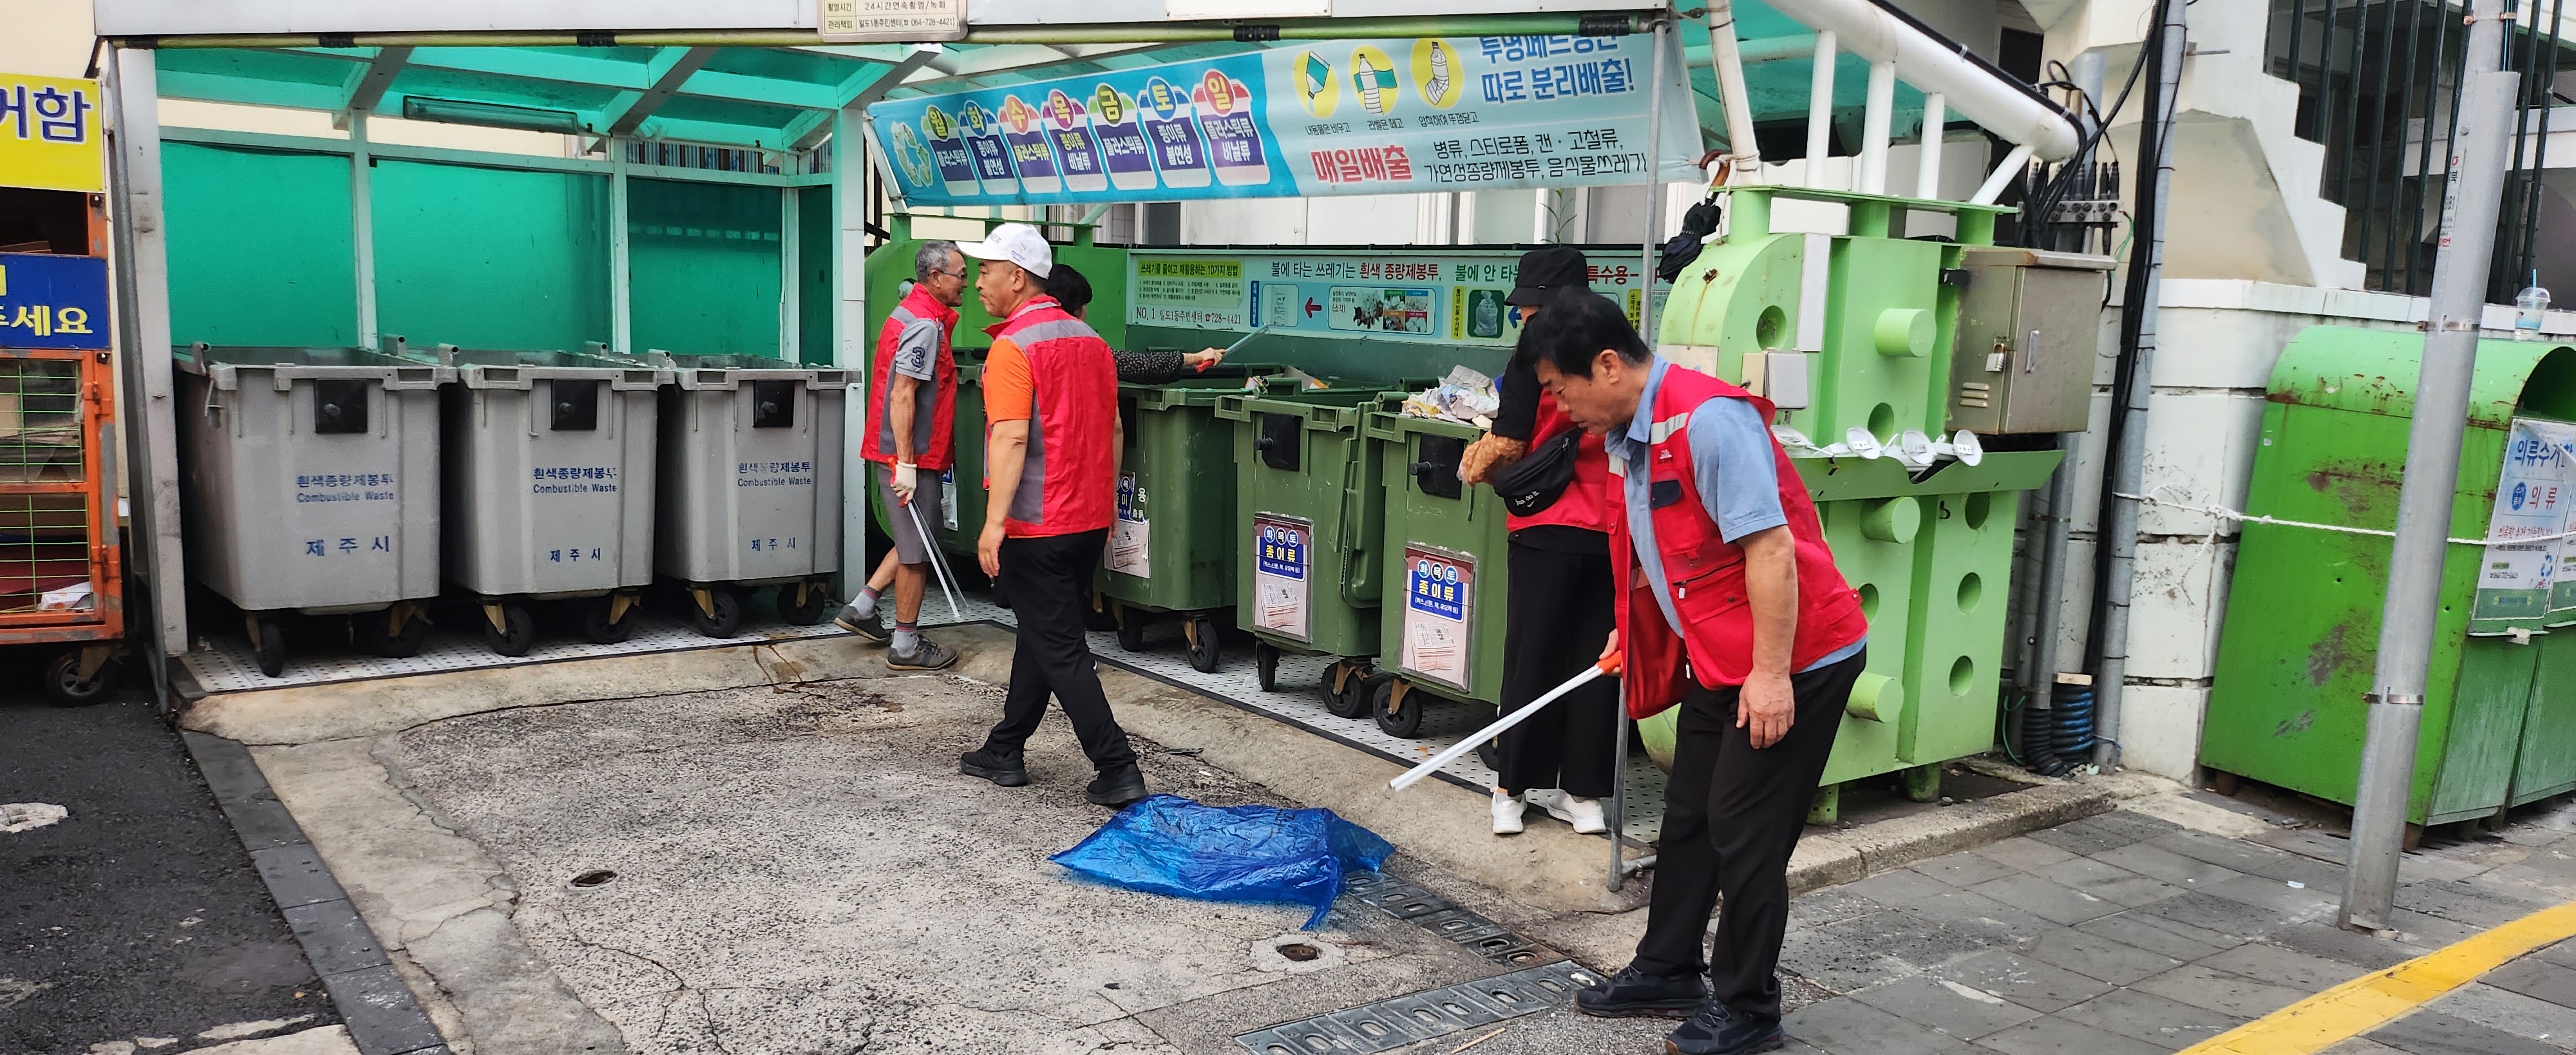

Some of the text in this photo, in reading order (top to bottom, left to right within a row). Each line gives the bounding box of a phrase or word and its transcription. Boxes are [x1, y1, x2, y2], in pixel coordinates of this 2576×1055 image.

[828, 3, 852, 12] 촬영시간
[828, 20, 853, 29] 관리책임
[1481, 57, 1634, 104] 따로 분리배출!
[931, 76, 1231, 137] 월 화 수 목 금 토 일
[1204, 118, 1254, 140] 플라스틱류
[1418, 111, 1479, 128] 압착하여 뚜껑닫고
[1059, 133, 1085, 151] 종이류
[1157, 124, 1187, 144] 종이류
[976, 140, 998, 157] 종이류
[1014, 143, 1050, 162] 플라스틱류
[1103, 135, 1144, 157] 플라스틱류
[1222, 140, 1251, 162] 비닐류
[1434, 129, 1624, 160] 병류, 스티로폼, 캔 고철류,
[936, 149, 969, 167] 플라스틱류
[1068, 152, 1092, 171] 비닐류
[1166, 144, 1193, 166] 불연성
[1311, 145, 1412, 183] 매일배출
[983, 157, 1005, 176] 불연성
[1424, 153, 1647, 183] 가연성종량제봉투, 음식물쓰레기
[1141, 263, 1238, 276] 쓰레기를 줄이고 재활용하는 10가지 방법
[1271, 261, 1442, 282] 불에 타는 쓰레기는 흰색 종량제봉투,
[1455, 264, 1479, 283] 불에
[1484, 265, 1496, 281] 안
[1151, 308, 1155, 319] 1
[1332, 303, 1345, 313] (소각)
[0, 305, 93, 337] 세요
[911, 347, 925, 368] 3
[533, 483, 618, 494] Combustible Waste
[738, 477, 811, 487] Combustible Waste
[296, 490, 395, 502] Combustible Waste
[1266, 529, 1273, 540] 화
[1289, 534, 1296, 544] 토
[1266, 545, 1296, 562] 종이류
[1419, 564, 1455, 581] 화 목 토
[1419, 579, 1454, 602] 종이류
